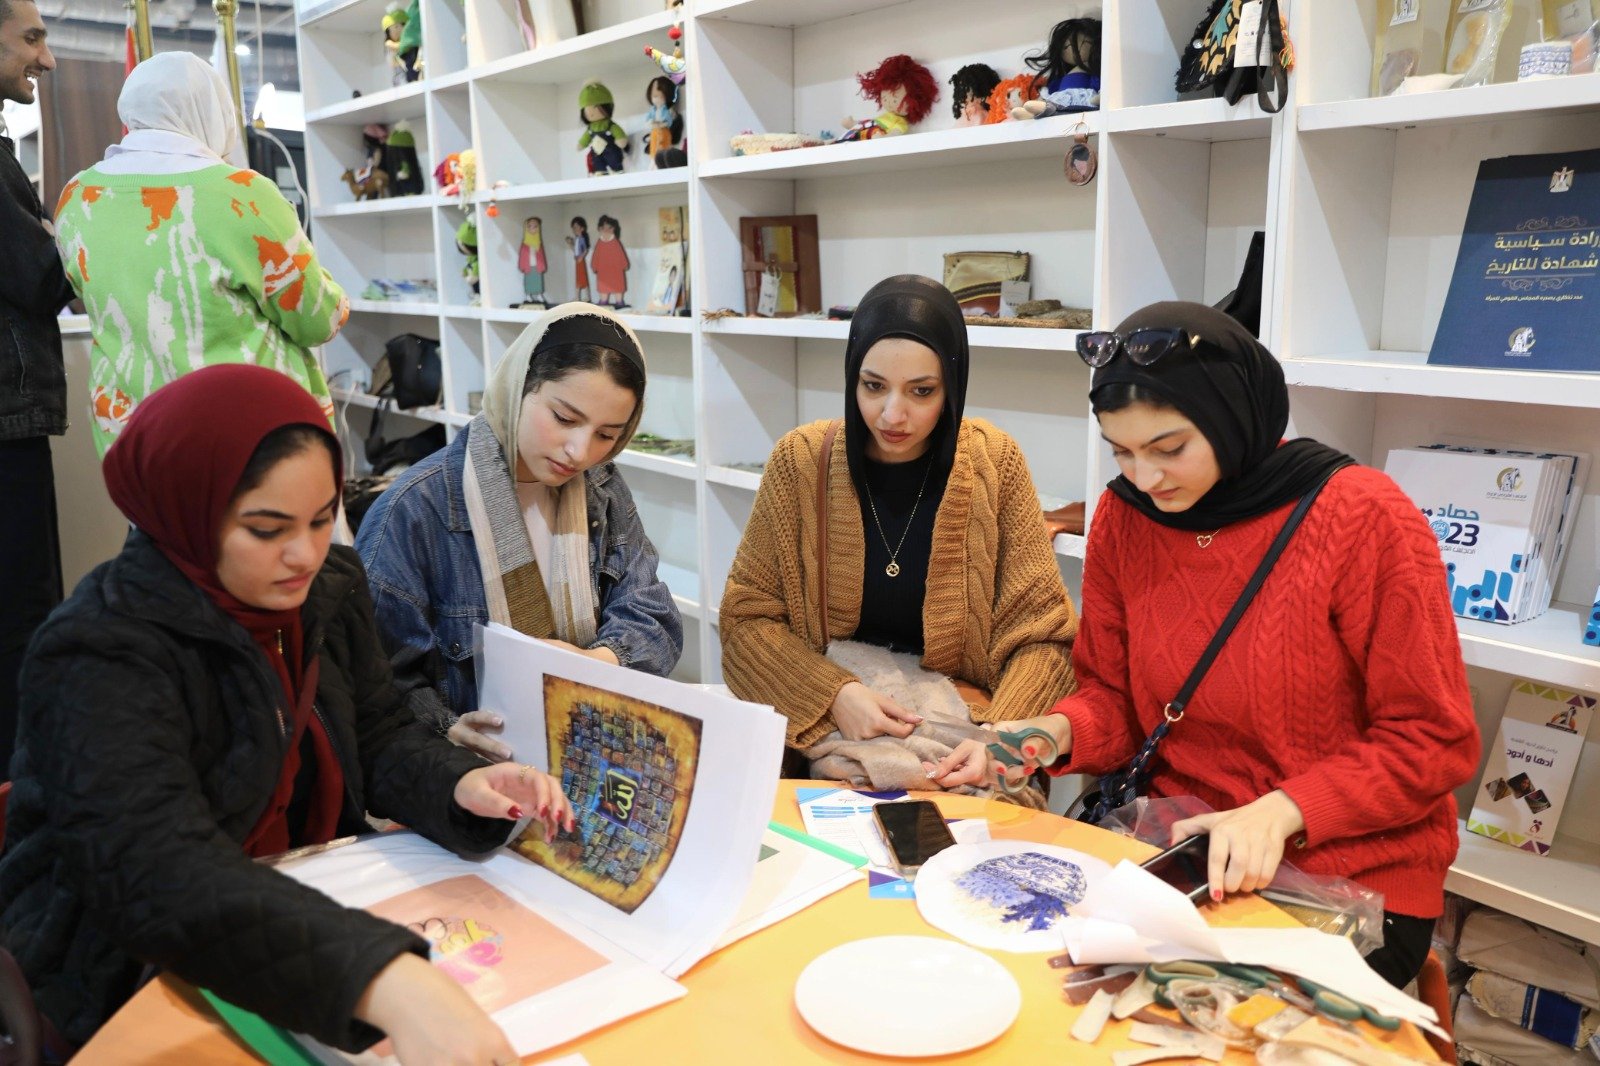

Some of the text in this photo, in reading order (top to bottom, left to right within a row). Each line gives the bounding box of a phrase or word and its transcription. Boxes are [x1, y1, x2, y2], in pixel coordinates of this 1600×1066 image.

[1494, 230, 1600, 251] رادة سياسية
[1485, 252, 1599, 275] شهادة للتاريخ
[1437, 503, 1480, 521] حصاد
